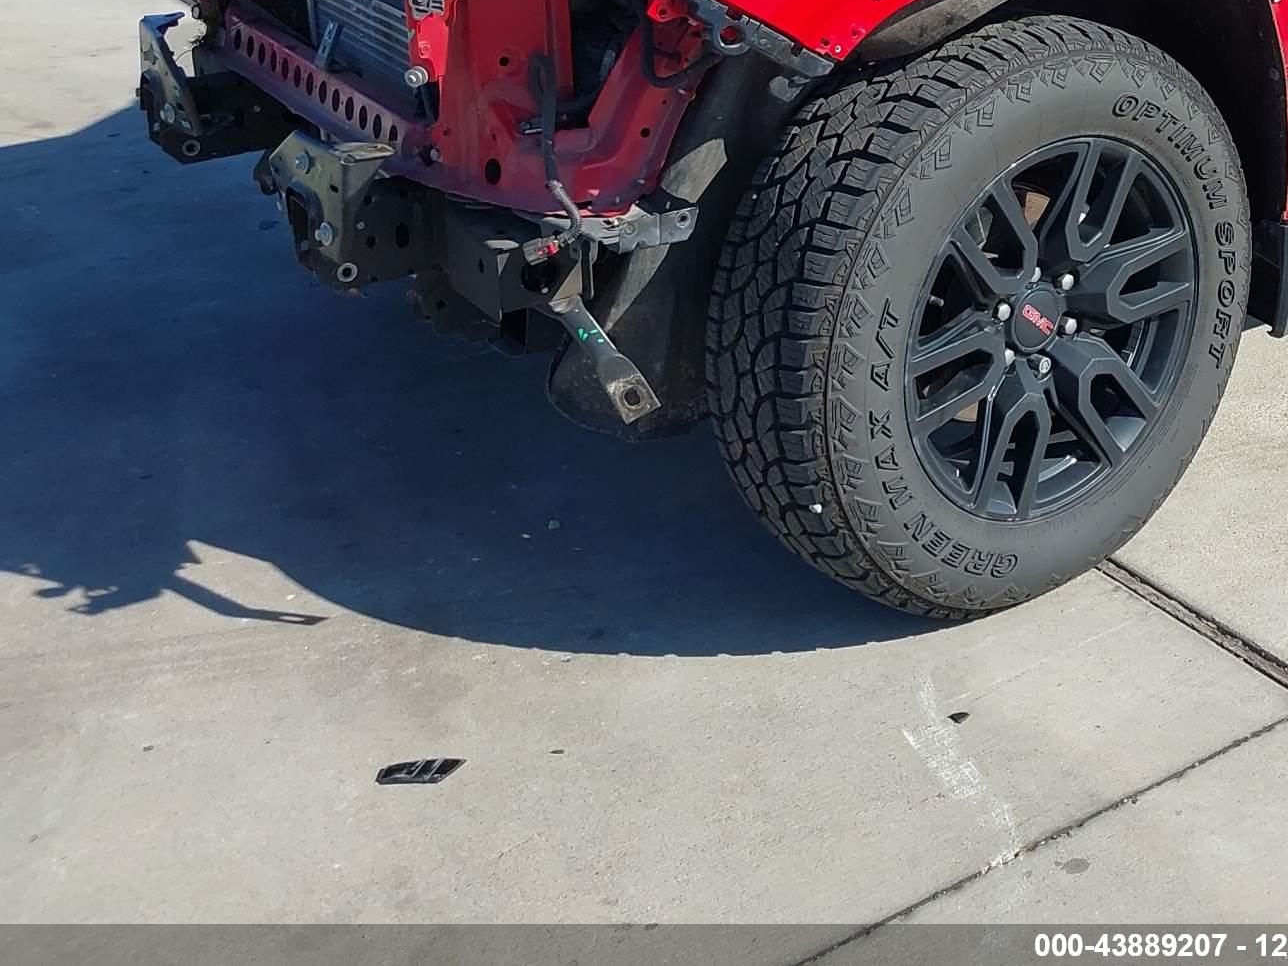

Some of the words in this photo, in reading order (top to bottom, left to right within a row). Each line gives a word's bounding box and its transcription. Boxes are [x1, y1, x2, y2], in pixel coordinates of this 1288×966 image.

[1112, 94, 1228, 211] OPTIMUM
[1215, 220, 1236, 370] SPORT
[870, 297, 900, 392] A/T
[1022, 304, 1054, 336] GMC
[869, 408, 913, 511] MAX
[903, 513, 1018, 578] GREEN
